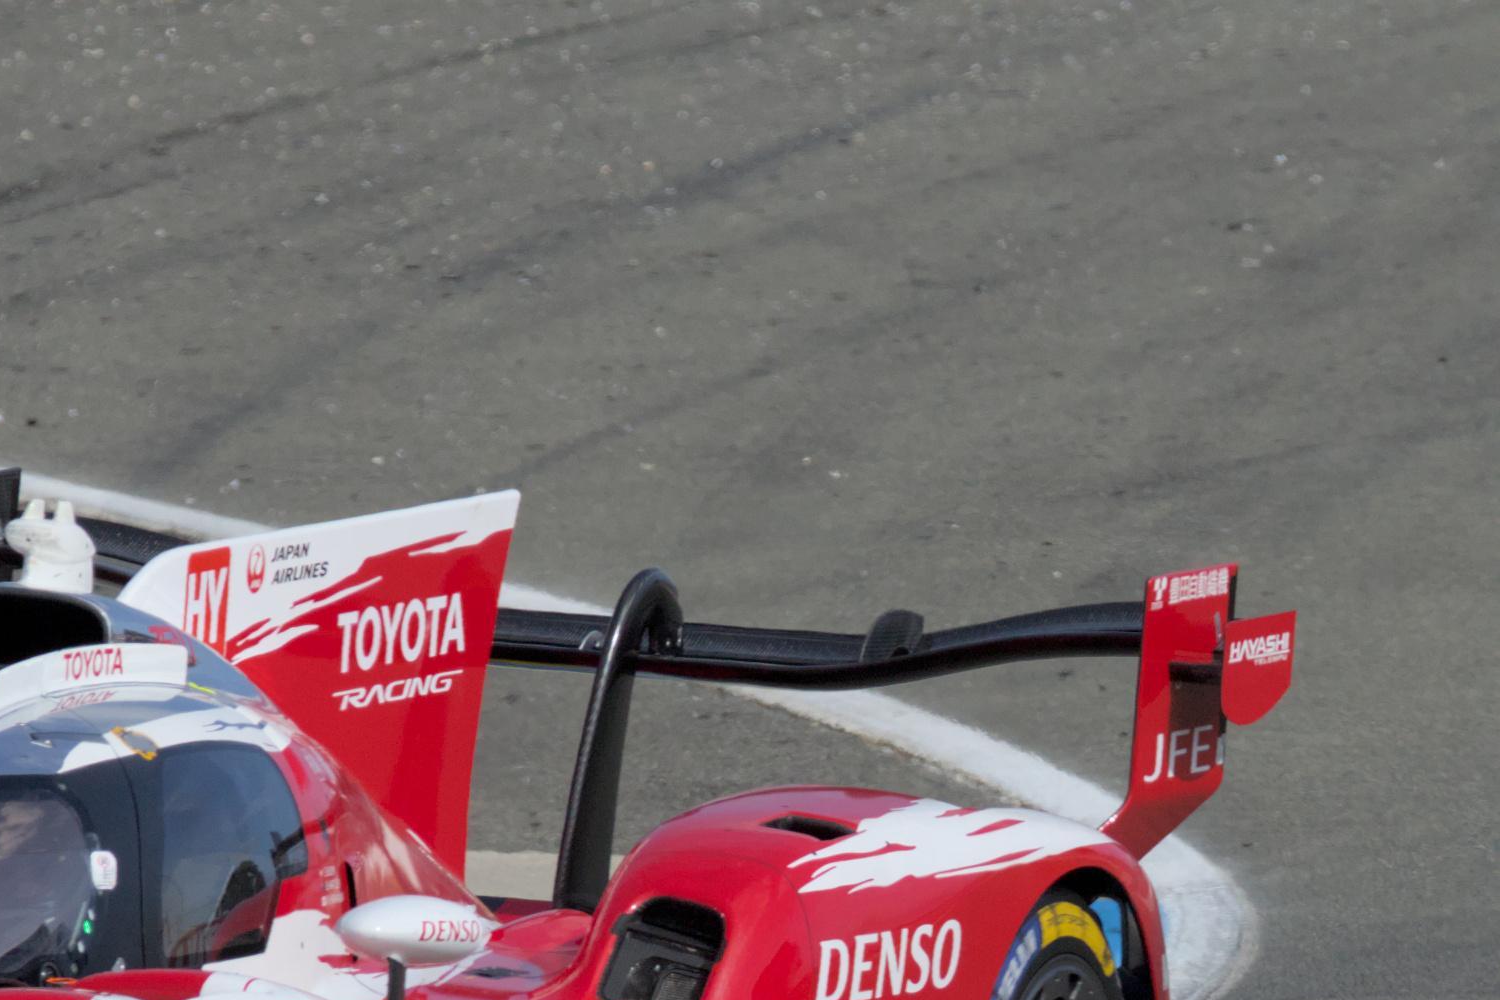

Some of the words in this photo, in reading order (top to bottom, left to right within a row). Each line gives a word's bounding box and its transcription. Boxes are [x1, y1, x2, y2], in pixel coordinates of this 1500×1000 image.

[271, 543, 310, 562] JAPAN
[272, 561, 329, 585] AIRLINES
[183, 567, 228, 644] HY
[337, 592, 466, 674] TOYOTA
[1228, 632, 1290, 664] HAYASHI
[62, 648, 124, 681] TOYOTA
[332, 669, 463, 711] RACING
[419, 920, 481, 942] DENSO
